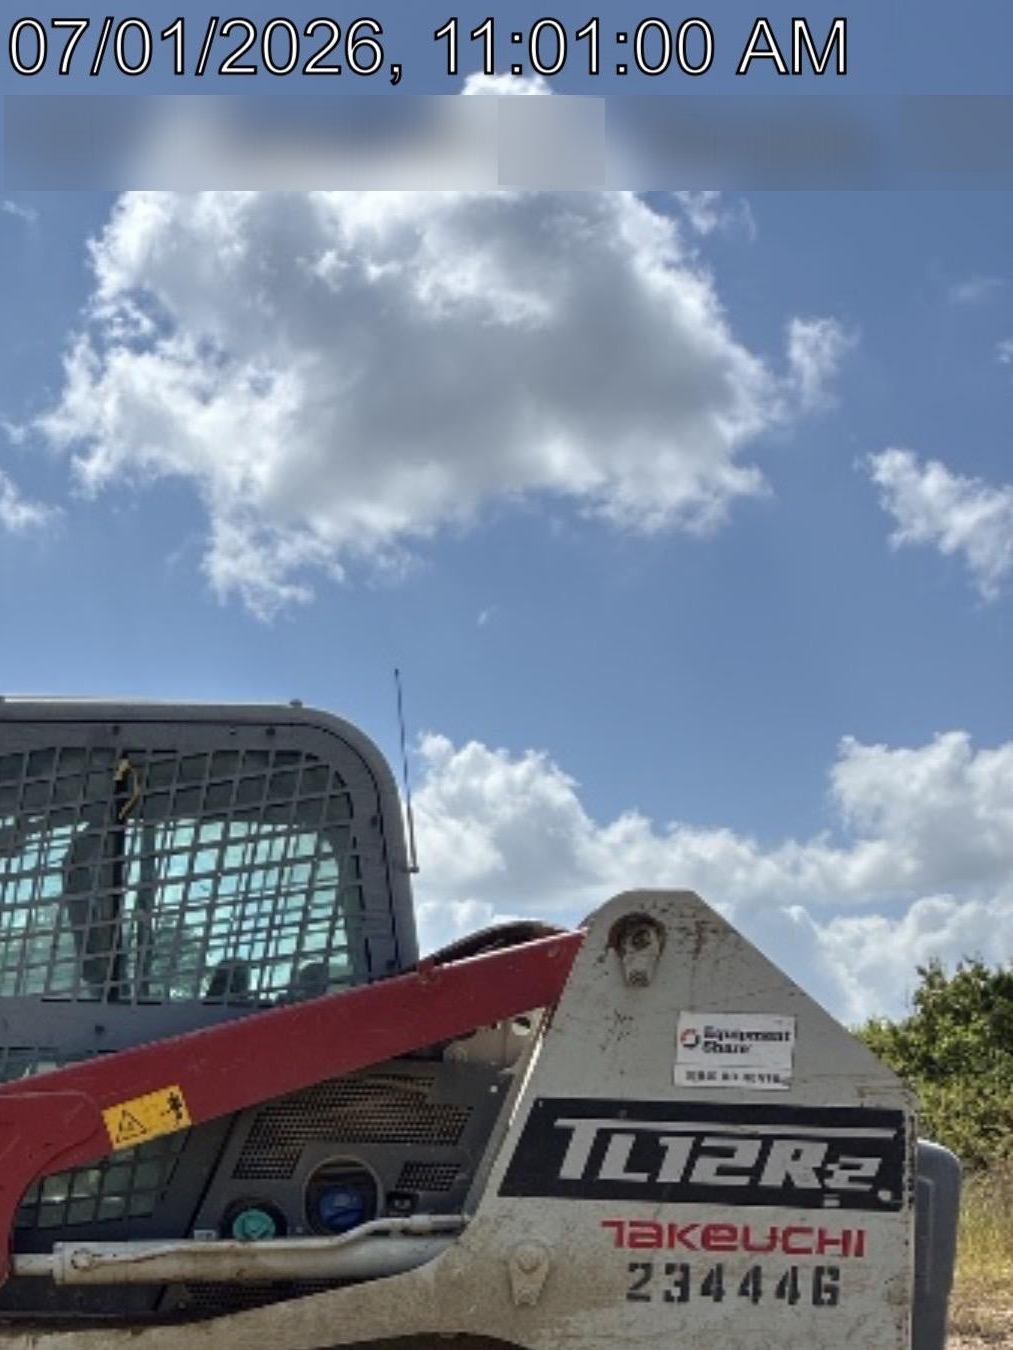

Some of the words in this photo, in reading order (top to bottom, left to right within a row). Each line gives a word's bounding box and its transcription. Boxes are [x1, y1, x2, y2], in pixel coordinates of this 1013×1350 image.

[703, 1025, 790, 1041] Equipment
[702, 1041, 751, 1053] Share
[625, 1262, 840, 1306] 234446
